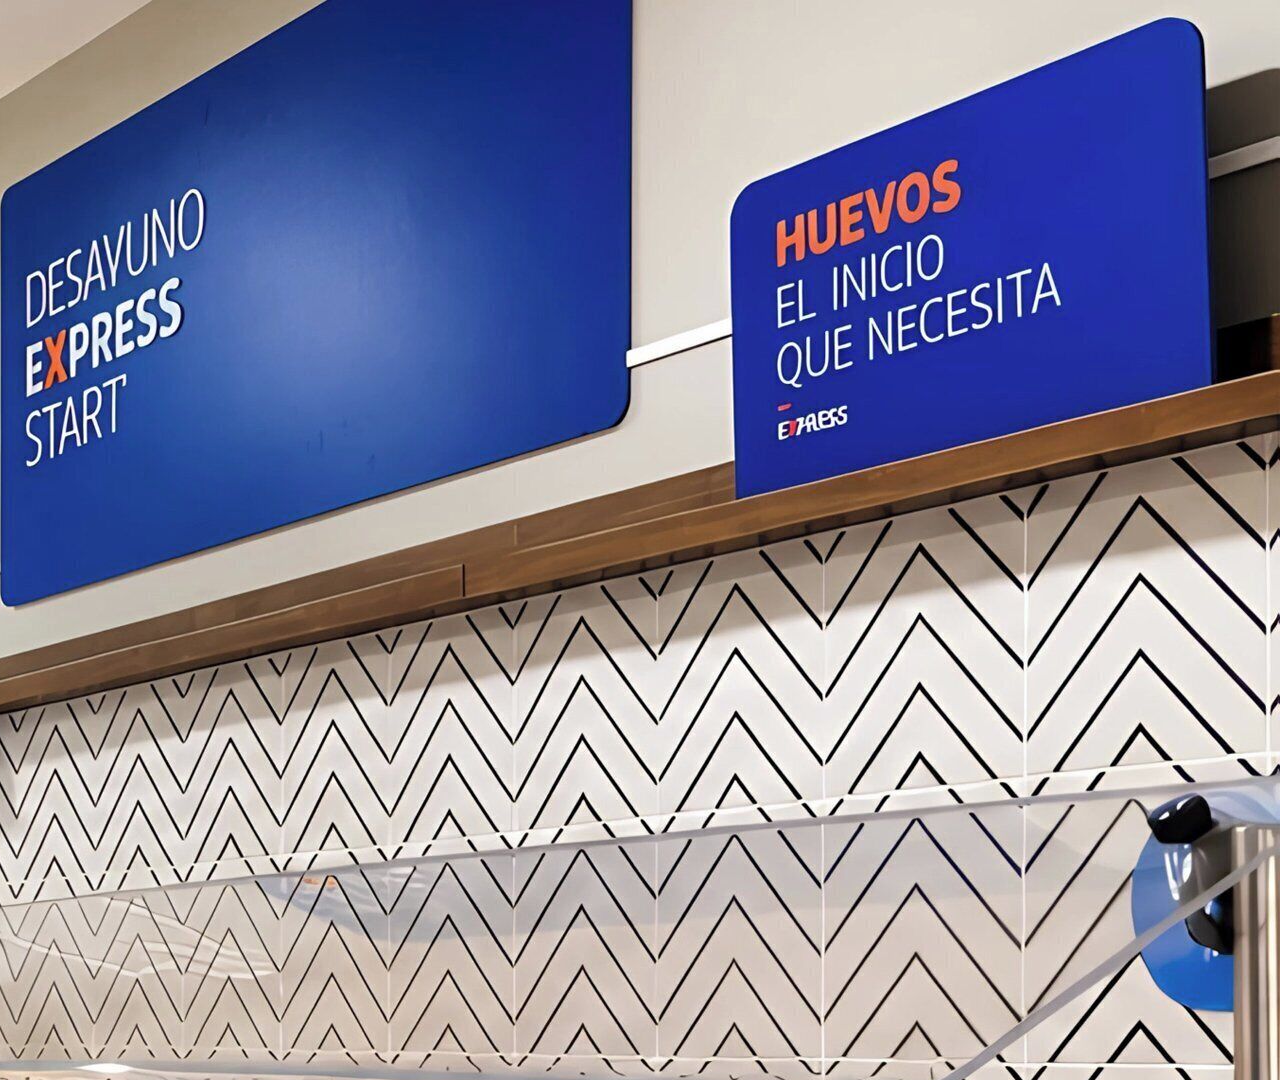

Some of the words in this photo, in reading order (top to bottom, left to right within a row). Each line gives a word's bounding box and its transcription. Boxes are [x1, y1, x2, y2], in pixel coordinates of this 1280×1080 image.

[26, 188, 205, 329] DESAYUNO
[776, 159, 962, 268] HUEVOS
[26, 277, 183, 398] EXPRESS
[777, 279, 817, 329] EL
[833, 234, 944, 311] INICIO
[777, 324, 853, 388] QUE
[869, 262, 1062, 361] NECESITA
[25, 373, 127, 468] START
